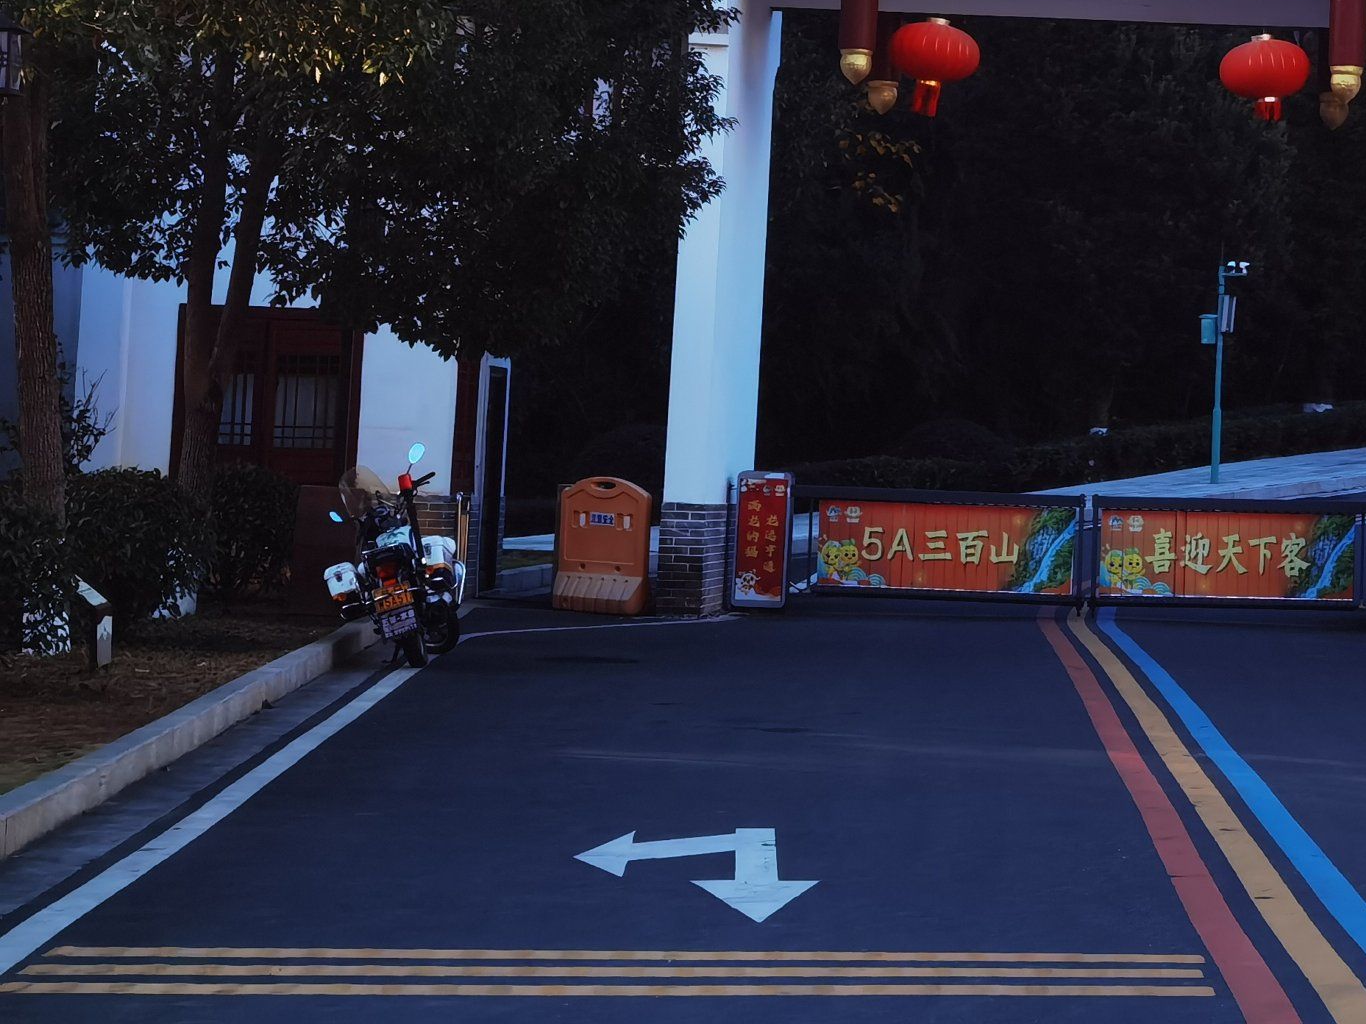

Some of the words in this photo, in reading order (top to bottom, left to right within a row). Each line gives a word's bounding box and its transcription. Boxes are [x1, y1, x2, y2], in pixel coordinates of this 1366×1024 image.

[861, 526, 1019, 566] 5A三百山
[1145, 527, 1311, 578] 喜迎天下客
